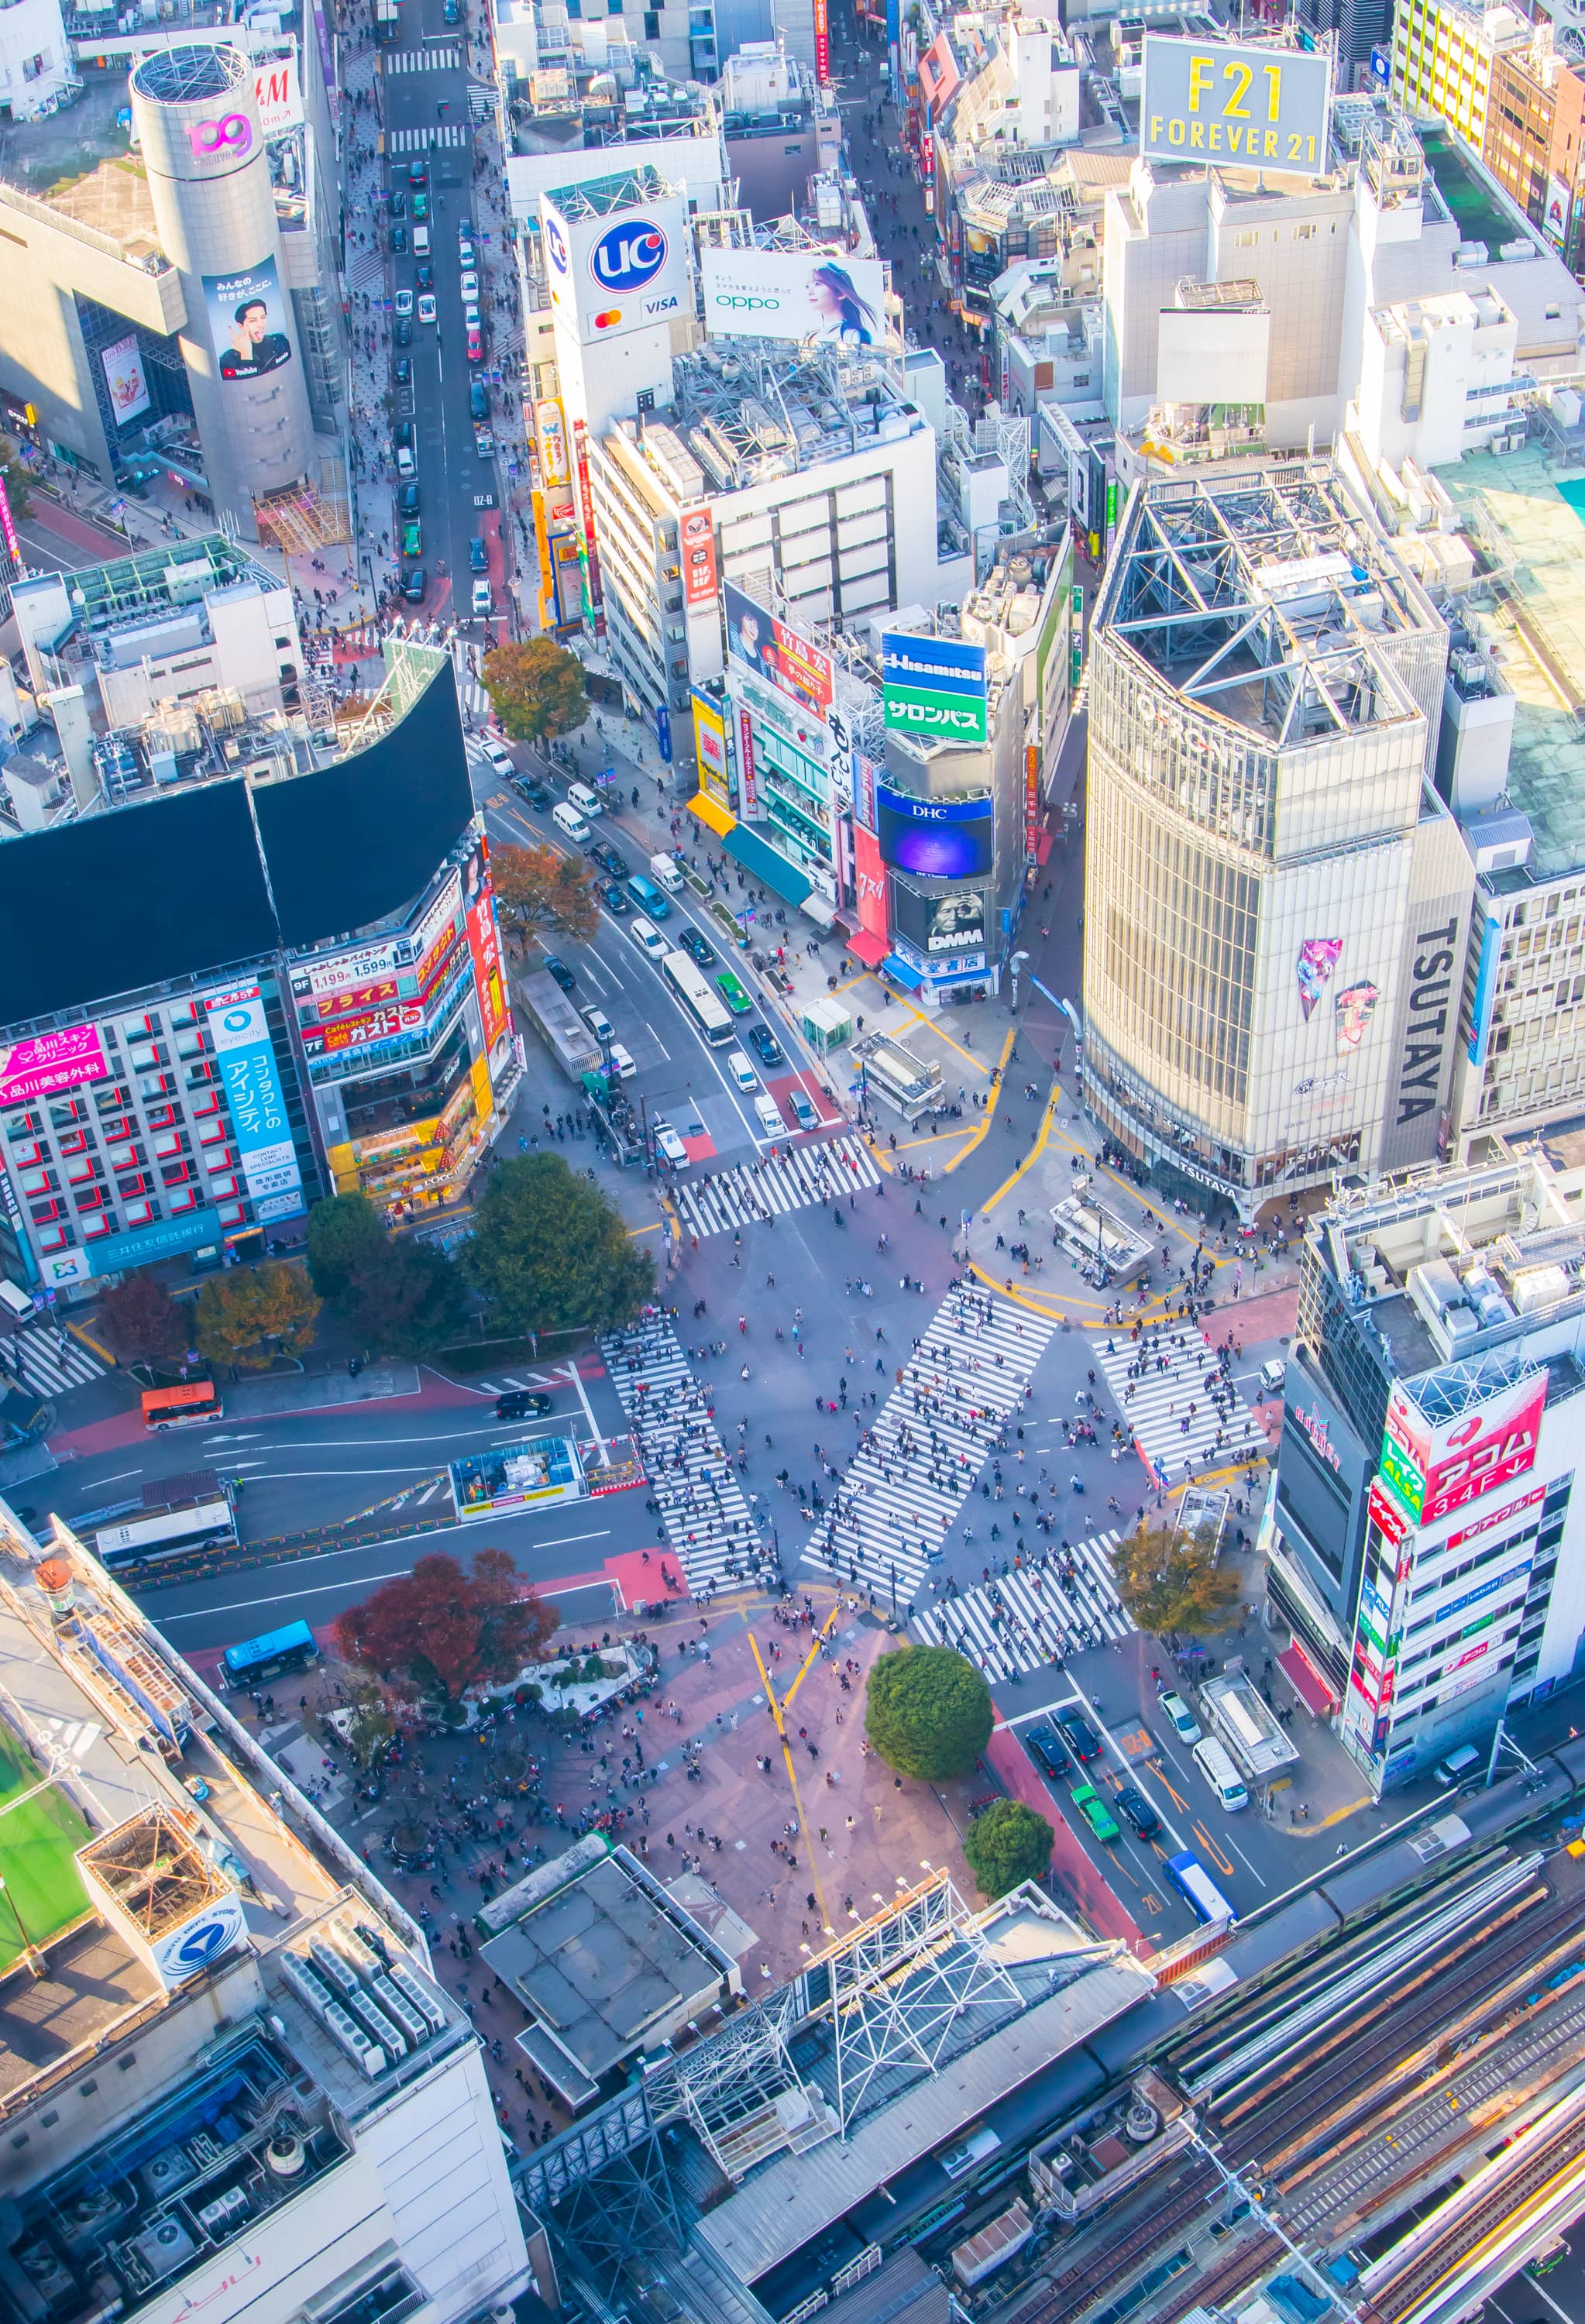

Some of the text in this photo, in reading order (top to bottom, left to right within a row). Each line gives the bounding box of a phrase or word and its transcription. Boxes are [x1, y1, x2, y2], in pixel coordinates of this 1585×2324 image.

[1188, 56, 1281, 122] F21
[184, 113, 253, 158] 109
[1150, 115, 1315, 162] FOREVER 21
[598, 232, 662, 277] UC
[216, 277, 252, 291] みんなの
[645, 296, 678, 314] VISA
[716, 295, 779, 310] oppo
[236, 366, 257, 376] YouTube
[882, 653, 982, 681] Hisamitsu
[888, 700, 980, 730] サロンパス
[913, 805, 947, 819] DHC
[928, 929, 983, 951] DMM
[314, 971, 352, 989] 1,199円
[354, 959, 393, 977] 1,599円
[294, 979, 310, 991] 9F
[318, 982, 395, 1014] プライス
[350, 1019, 397, 1043] ガスト
[1397, 917, 1458, 1126] TSUTAYA
[33, 1031, 91, 1054] 品川スキン
[221, 1030, 261, 1045] eyecity
[306, 1039, 324, 1053] 7F
[36, 1041, 88, 1064] クリニック
[9, 1061, 101, 1098] 品川美容外科
[252, 1054, 281, 1129] コンタクトの
[226, 1060, 262, 1134] アイシティ
[1287, 1139, 1360, 1165] TSUTAYA
[1180, 1161, 1236, 1199] TSUTAYA
[1435, 1432, 1533, 1498] アコム
[1384, 1459, 1422, 1511] ALSA
[1481, 1499, 1528, 1529] アイフル
[1141, 1893, 1162, 1914] 20
